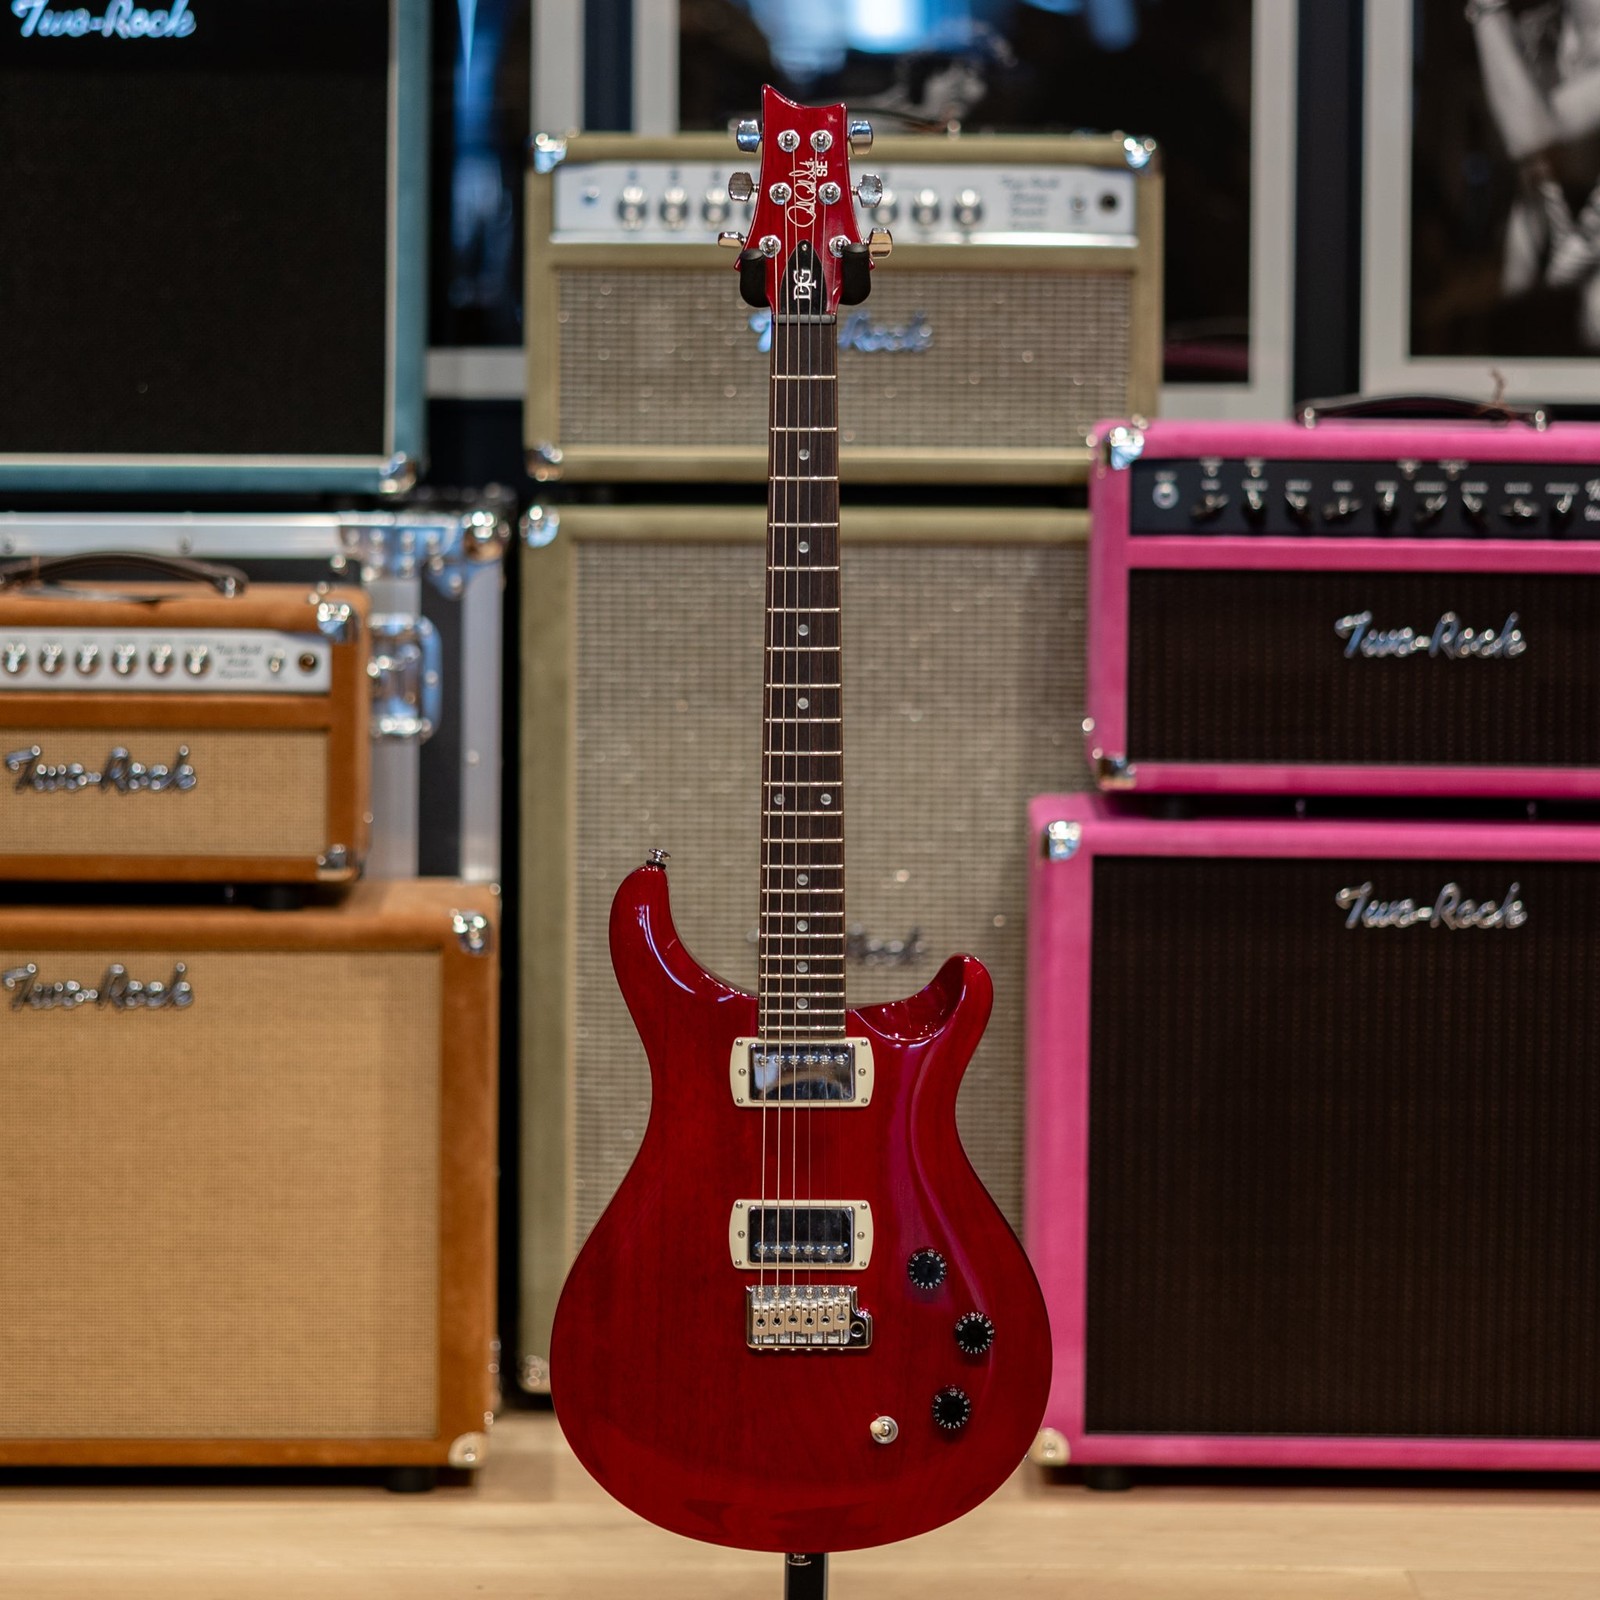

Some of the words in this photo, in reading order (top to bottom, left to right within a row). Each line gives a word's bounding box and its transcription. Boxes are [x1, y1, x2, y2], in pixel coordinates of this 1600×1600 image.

[11, 0, 197, 38] Two-Rock
[1334, 610, 1527, 659] Two-Rock
[5, 745, 197, 793] Two-Rock
[1335, 881, 1528, 930] Two-Rock
[2, 962, 194, 1010] Two-Rock
